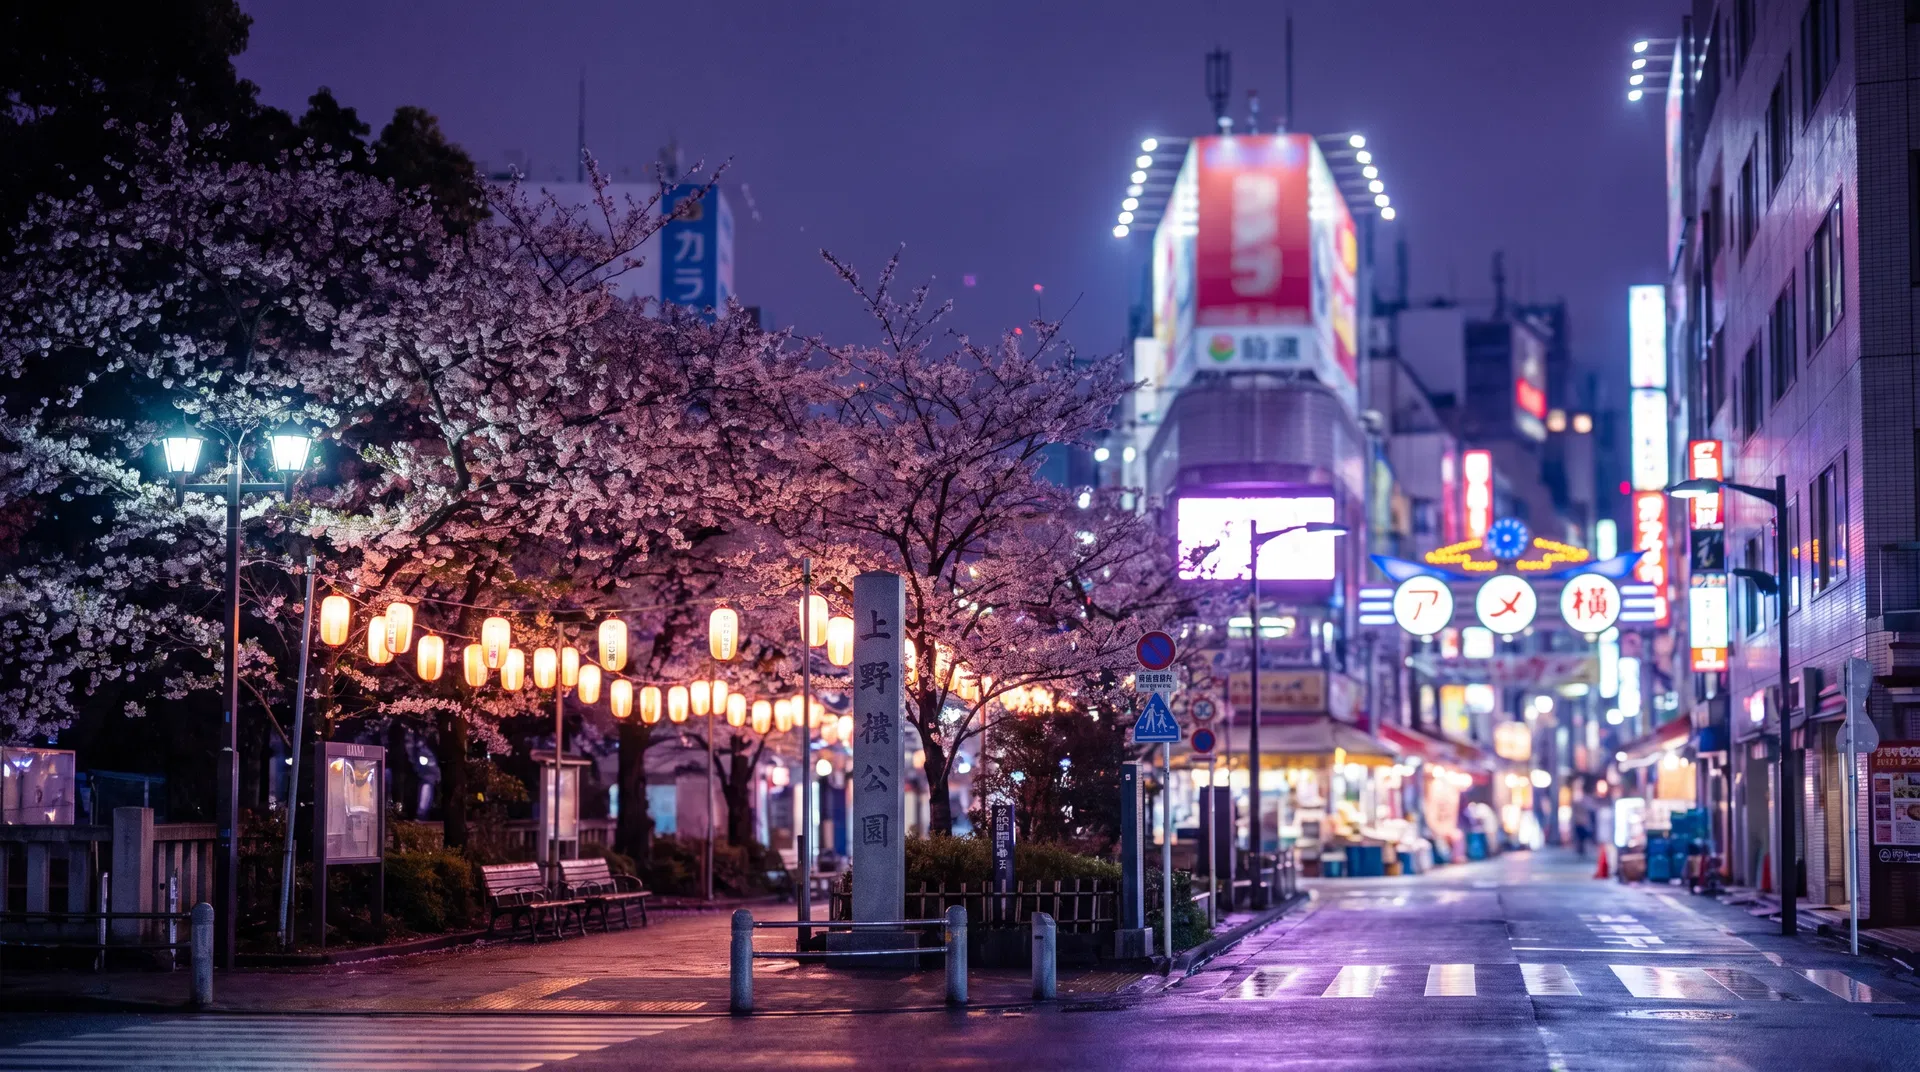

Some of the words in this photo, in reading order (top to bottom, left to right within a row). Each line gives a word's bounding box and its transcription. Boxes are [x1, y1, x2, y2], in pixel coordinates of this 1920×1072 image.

[674, 230, 705, 301] カラ
[1408, 587, 1607, 620] アメ横
